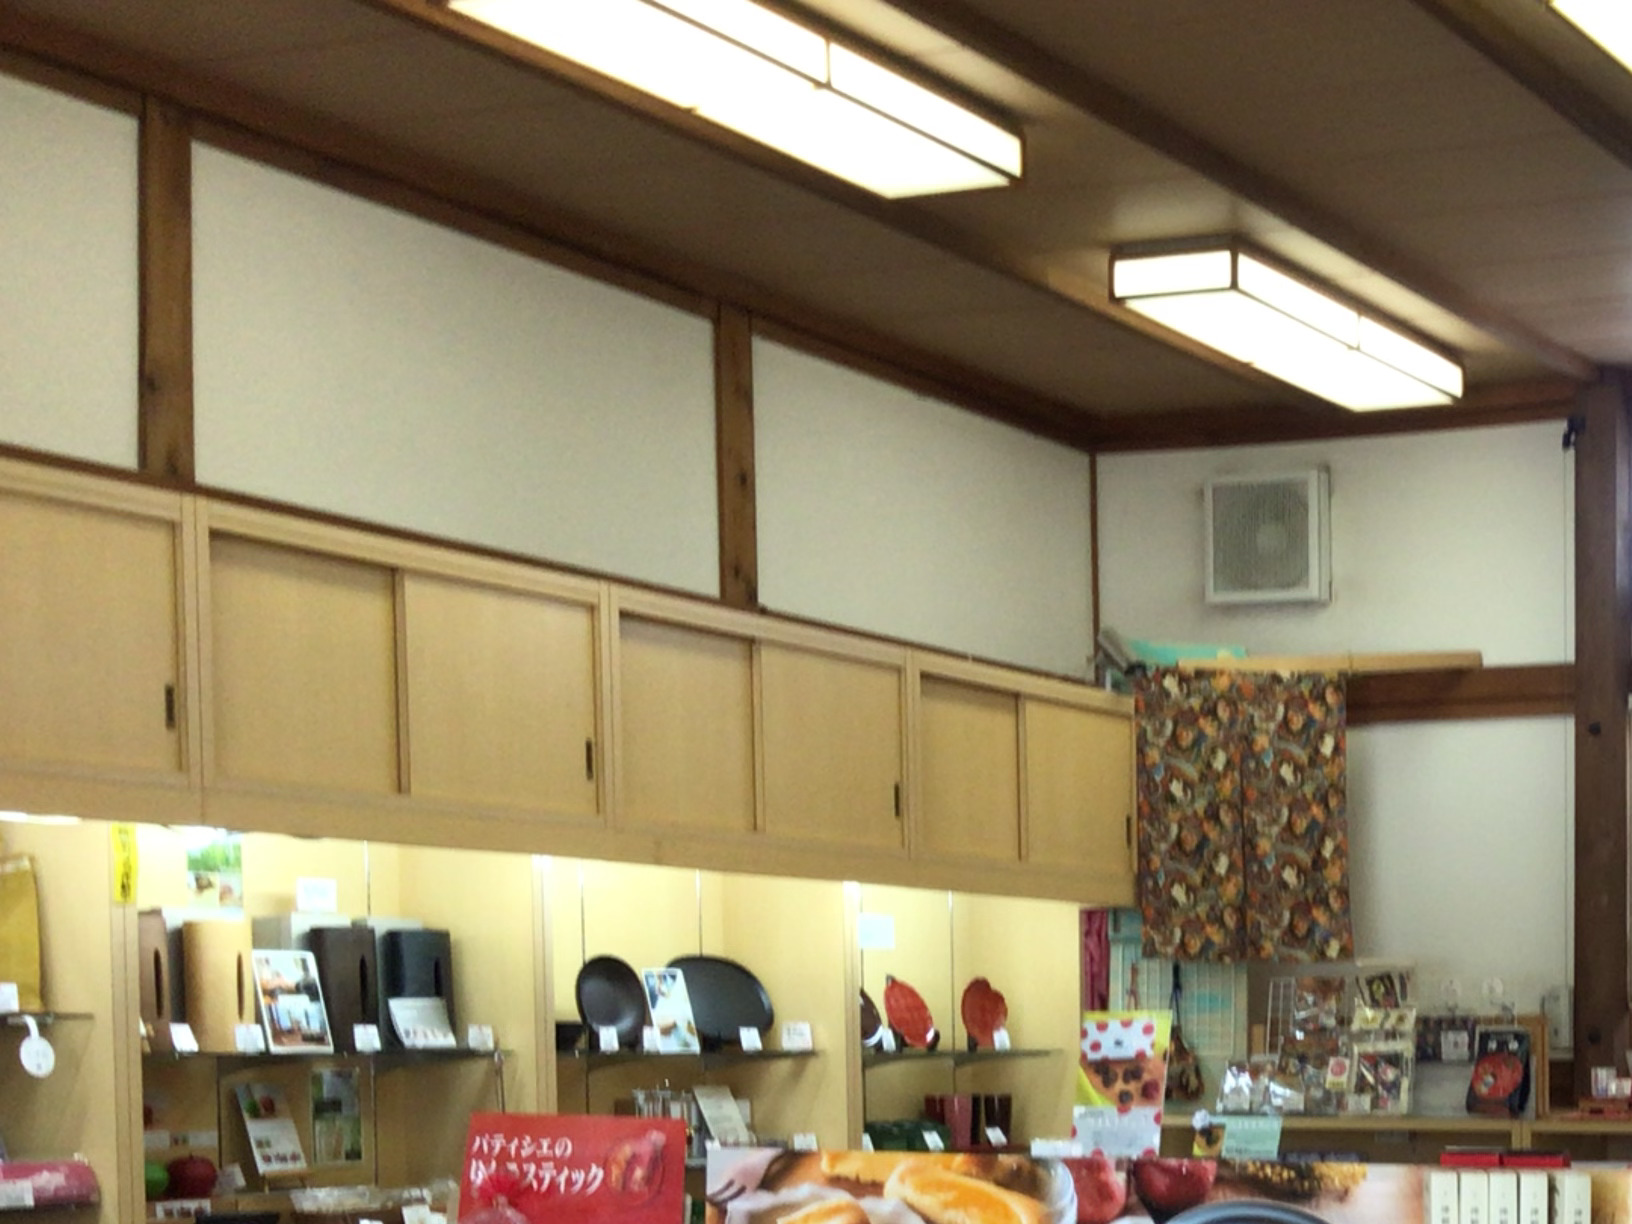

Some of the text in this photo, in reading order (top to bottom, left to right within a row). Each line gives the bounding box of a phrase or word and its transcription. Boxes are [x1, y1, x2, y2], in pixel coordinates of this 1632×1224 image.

[472, 1132, 573, 1158] パティシエの
[470, 1158, 604, 1195] りスティック
